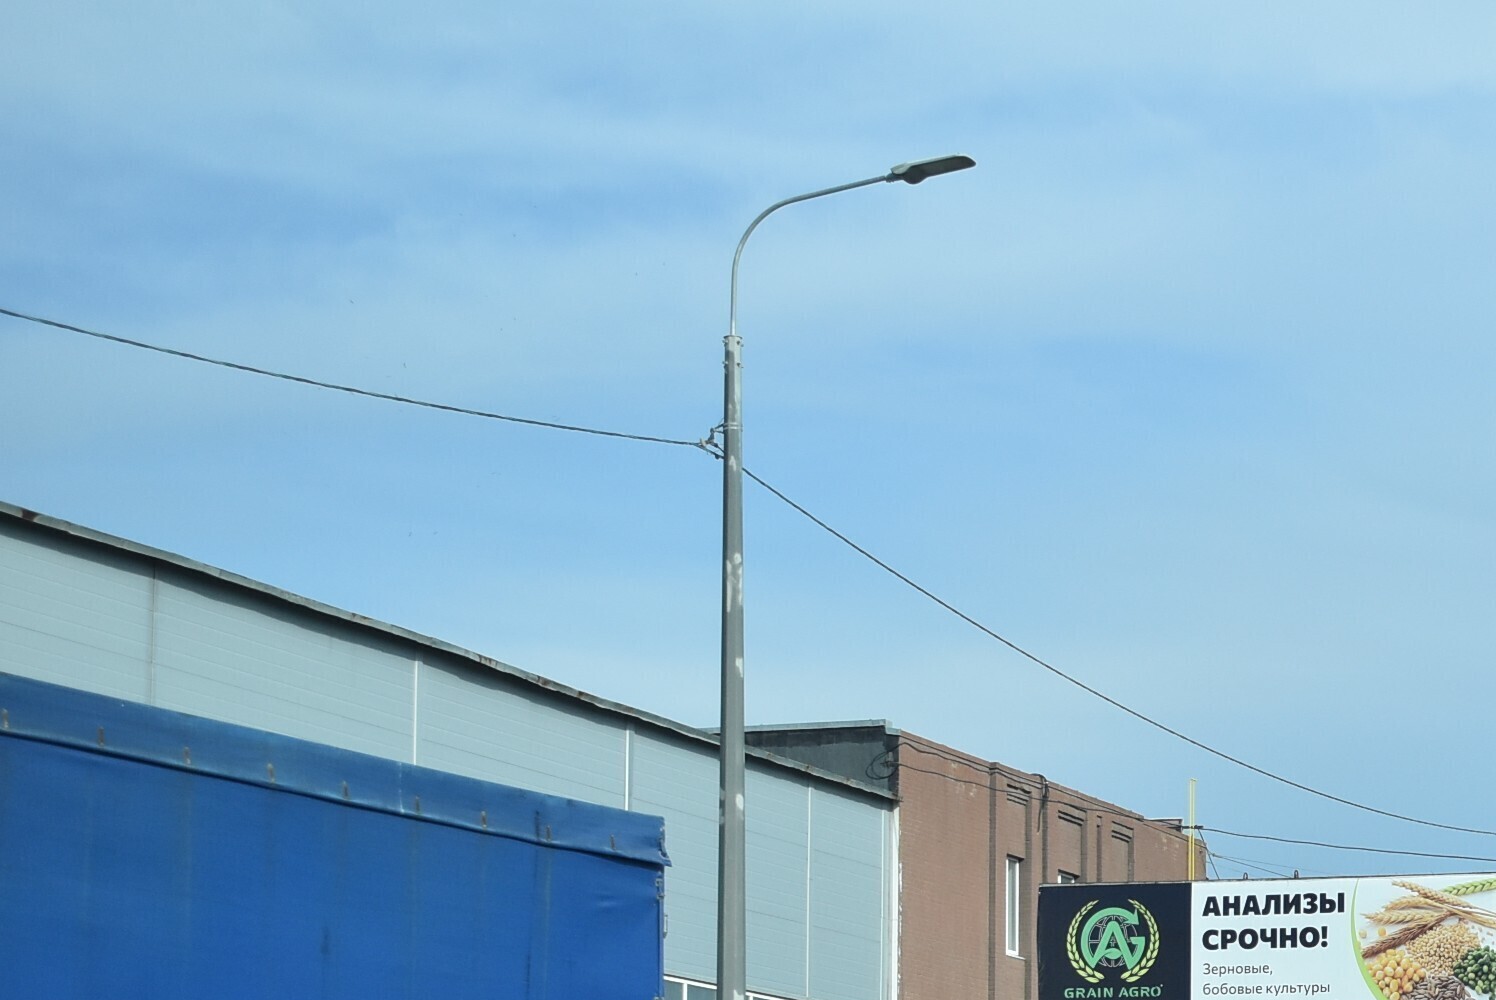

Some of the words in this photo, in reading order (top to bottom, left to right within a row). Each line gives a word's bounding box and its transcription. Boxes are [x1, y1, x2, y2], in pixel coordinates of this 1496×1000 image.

[1202, 892, 1345, 917] АНАЛИЗЫ
[1202, 926, 1328, 950] СРОЧНО!
[1202, 963, 1273, 977] Зерновые,
[1064, 987, 1113, 999] GRAIN
[1202, 983, 1263, 996] бобовые
[1266, 983, 1330, 997] культуры
